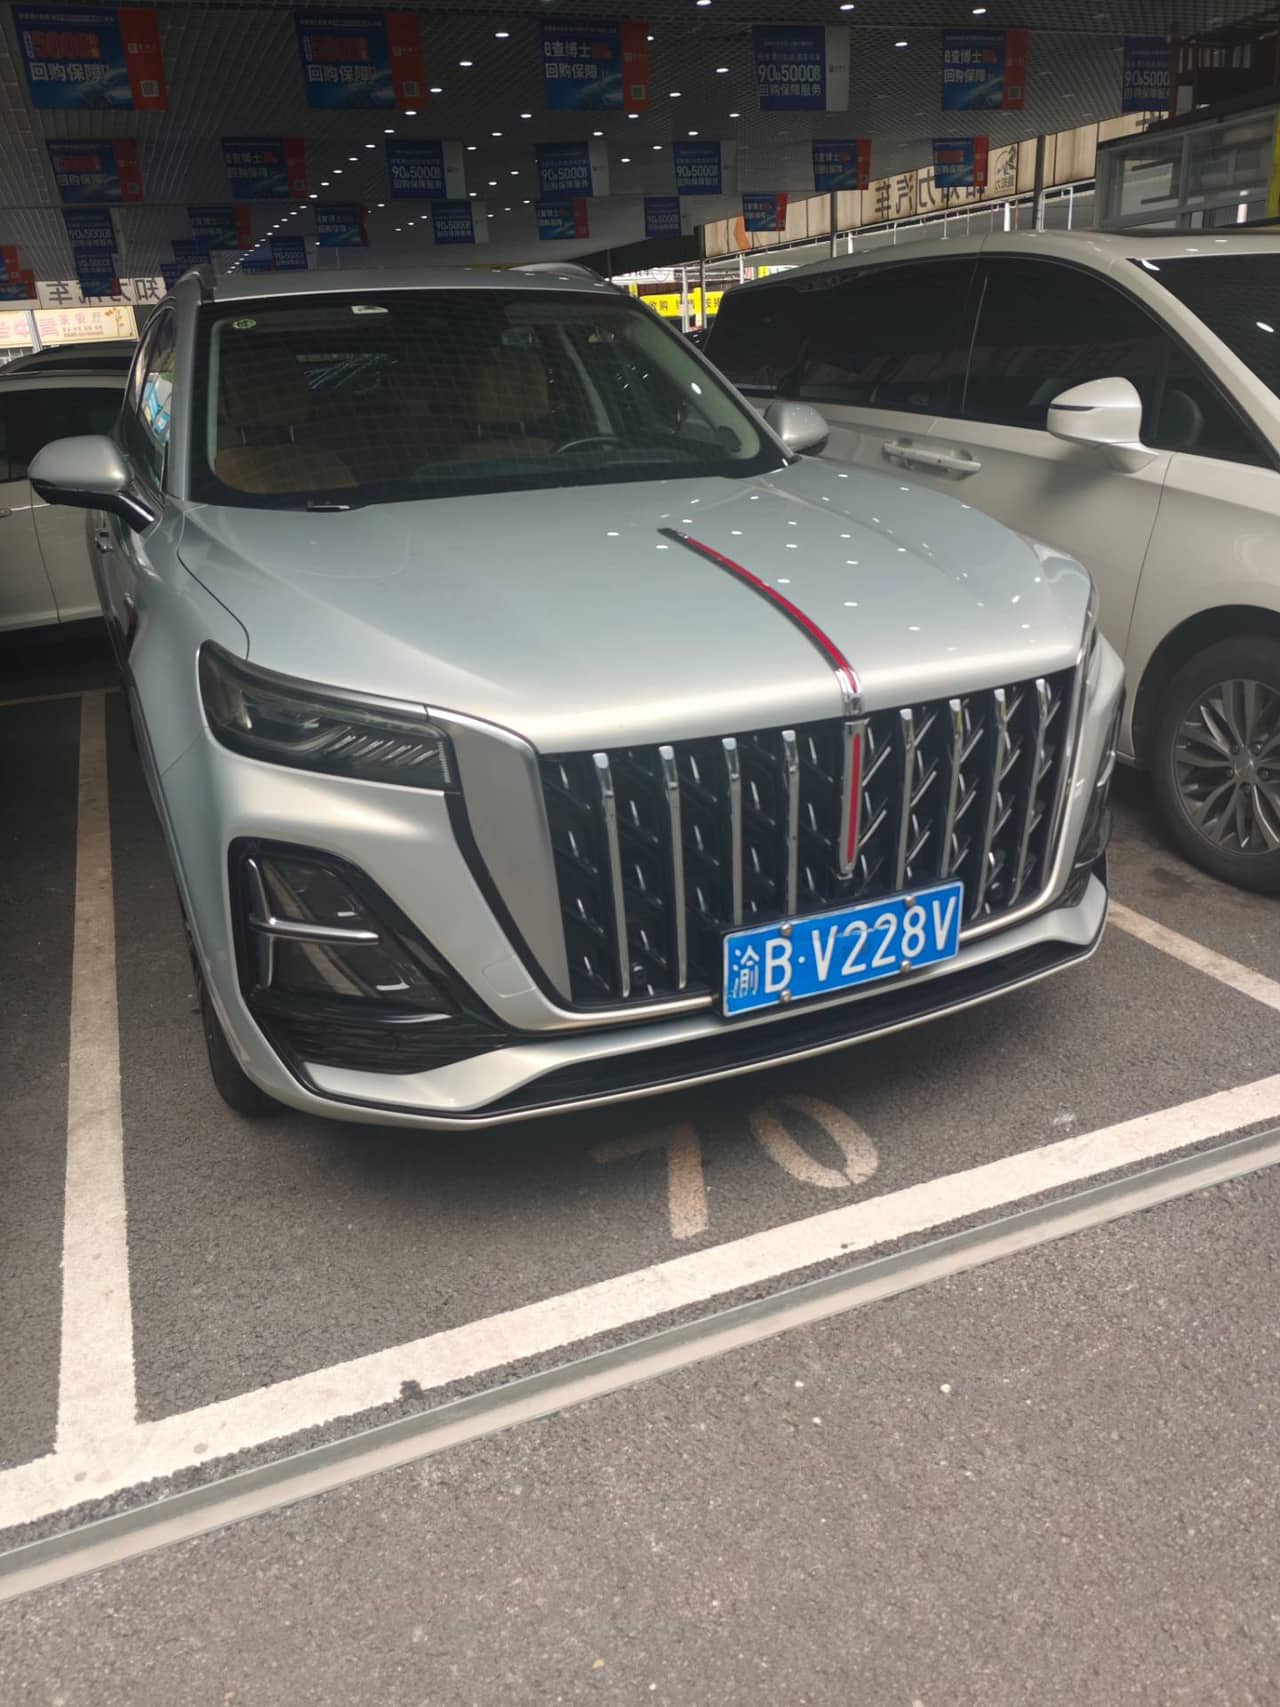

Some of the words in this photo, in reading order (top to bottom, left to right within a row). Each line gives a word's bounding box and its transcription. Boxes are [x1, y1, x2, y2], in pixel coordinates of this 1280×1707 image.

[544, 63, 599, 80] 回购保障
[727, 896, 957, 1000] 渝B·V228V
